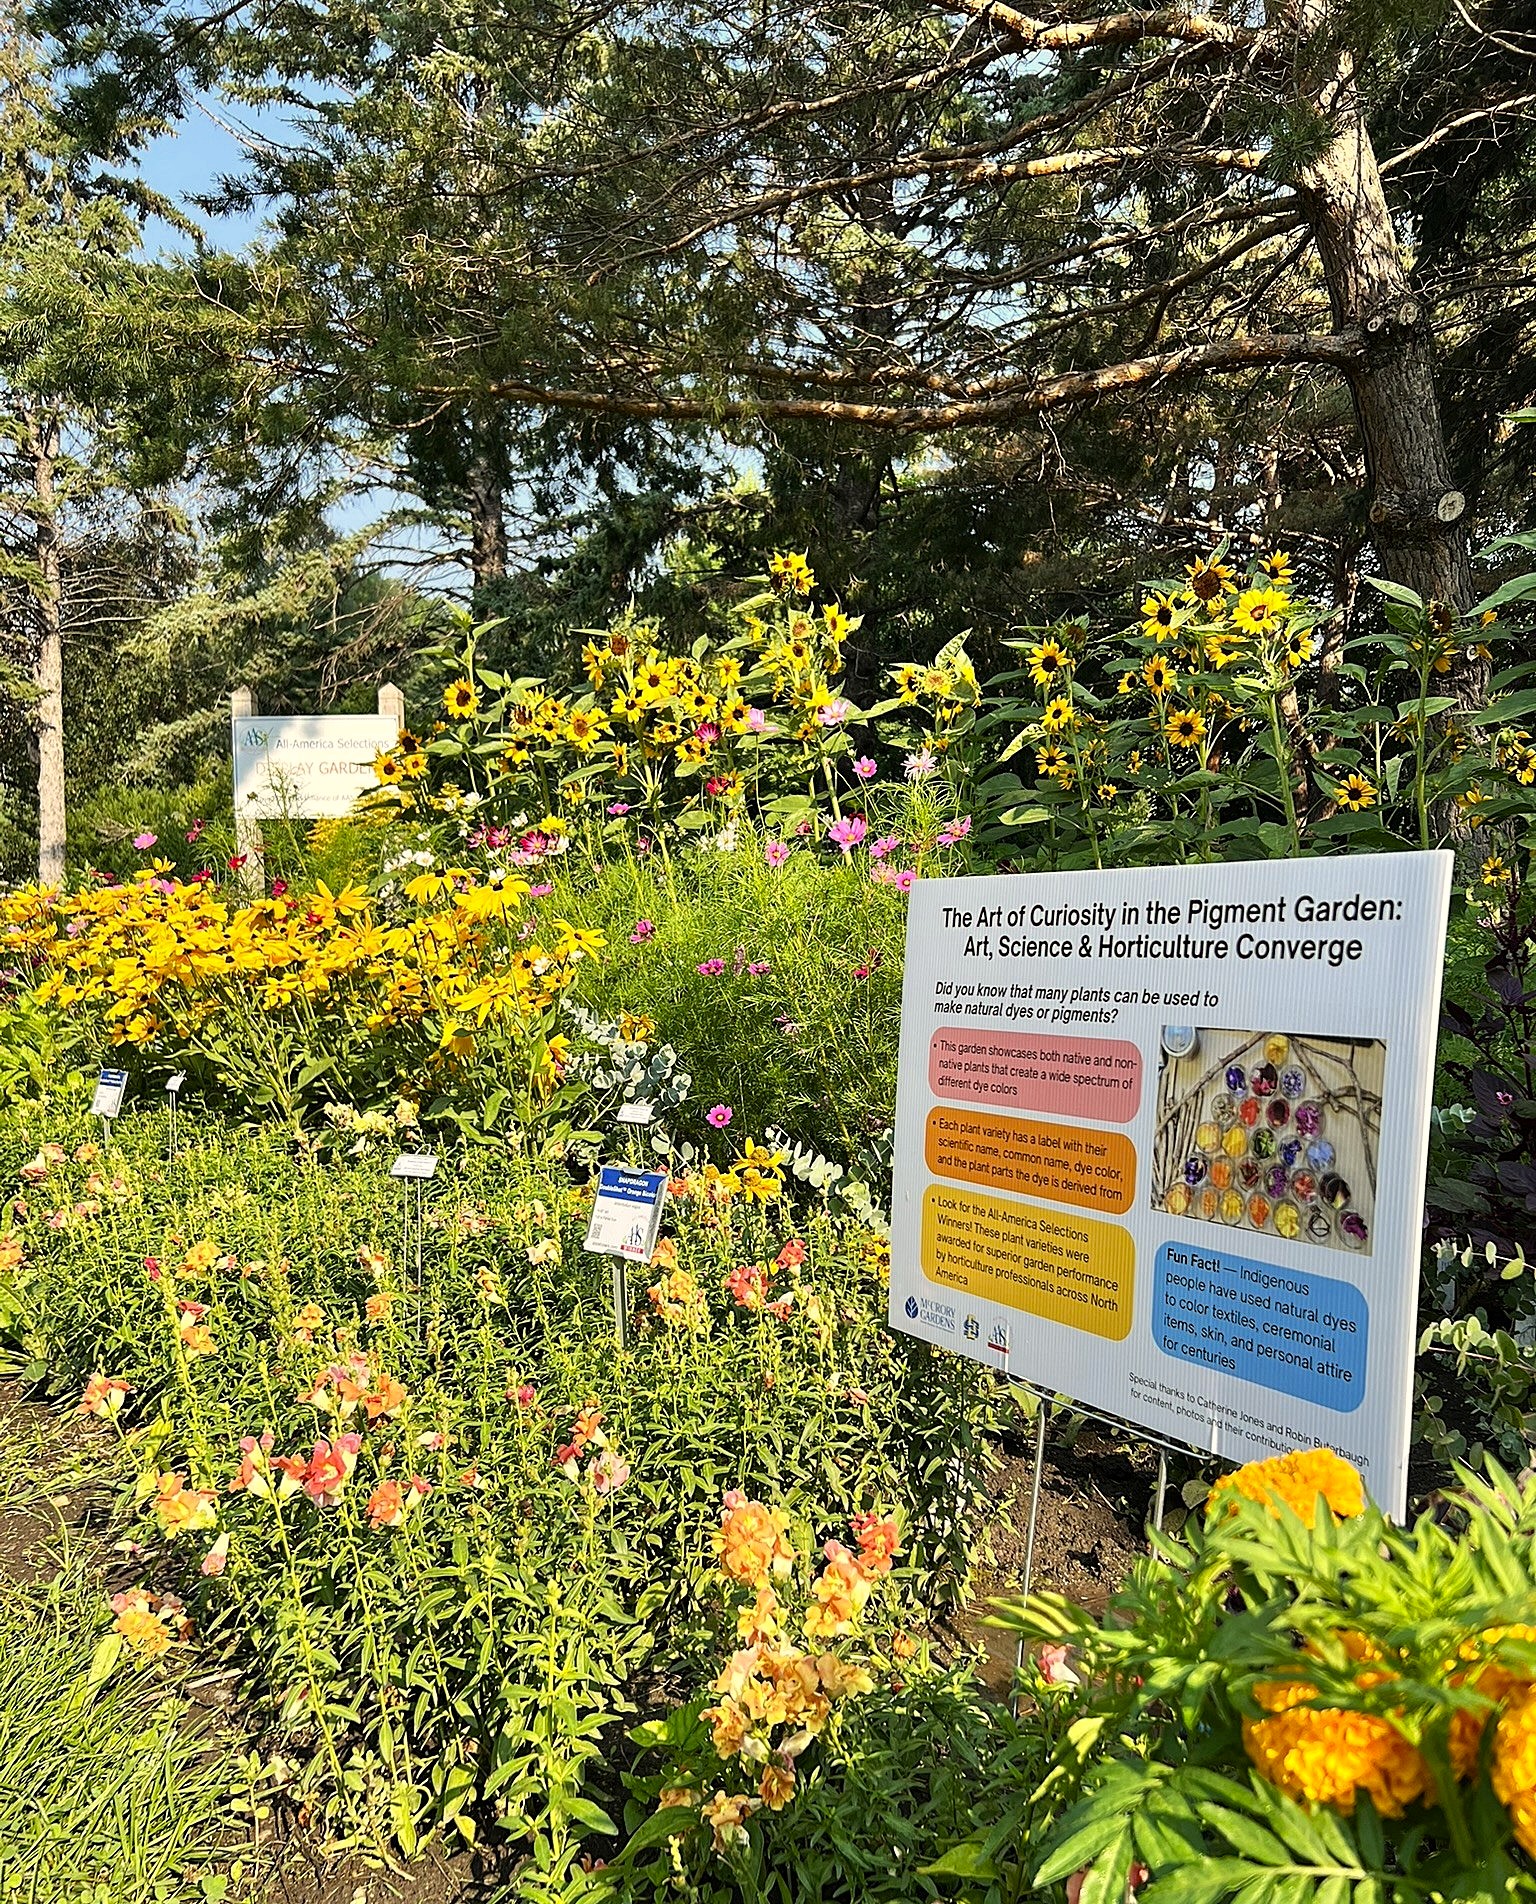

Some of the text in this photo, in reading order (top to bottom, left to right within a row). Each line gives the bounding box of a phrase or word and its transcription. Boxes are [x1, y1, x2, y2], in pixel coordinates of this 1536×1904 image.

[276, 739, 390, 748] All-America Selections
[256, 762, 314, 775] DPLAY
[943, 894, 1402, 931] The Art of Curiosity in the Pigment Garden:
[964, 934, 1362, 967] Art, Science & Horticulture Converge
[934, 1001, 1118, 1023] make natural dyes or pigments?
[935, 982, 1219, 1007] Did you know that many plants can be used to
[939, 1059, 1133, 1090] native plants that create a wide spectrum of
[940, 1040, 1137, 1070] This garden showcases both native and non-
[938, 1076, 1018, 1095] different dye colors
[939, 1118, 1107, 1157] Each plant variety has a label with their
[937, 1154, 1123, 1200] and the plant parts the dye is derived from
[938, 1137, 1123, 1182] scientific name, common name, dye color,
[937, 1213, 1090, 1263] Winners! These plant varieties were
[938, 1196, 1089, 1243] Look for the All-America Selections
[936, 1232, 1118, 1291] awarded for superior garden performance
[936, 1266, 969, 1286] America
[936, 1249, 1118, 1313] by horticulture professionals across North
[1167, 1248, 1187, 1265] Fun
[1191, 1254, 1220, 1273] Fact!
[1241, 1266, 1310, 1295] Indigenous
[920, 1310, 955, 1330] GARDENS
[1166, 1272, 1357, 1333] people have used natural dyes
[1165, 1293, 1336, 1352] to color textiles, ceremonial
[1163, 1313, 1353, 1382] items, skin, and personal attire
[1163, 1335, 1236, 1370] for centuries
[1129, 1372, 1157, 1390] Special
[1159, 1382, 1185, 1400] thanks
[1187, 1393, 1195, 1404] to
[1197, 1396, 1238, 1419] Catherine
[1240, 1410, 1265, 1429] Jones
[1266, 1421, 1283, 1435] and
[1286, 1427, 1311, 1446] Robin
[1130, 1388, 1299, 1454] for content, photos and their contributio
